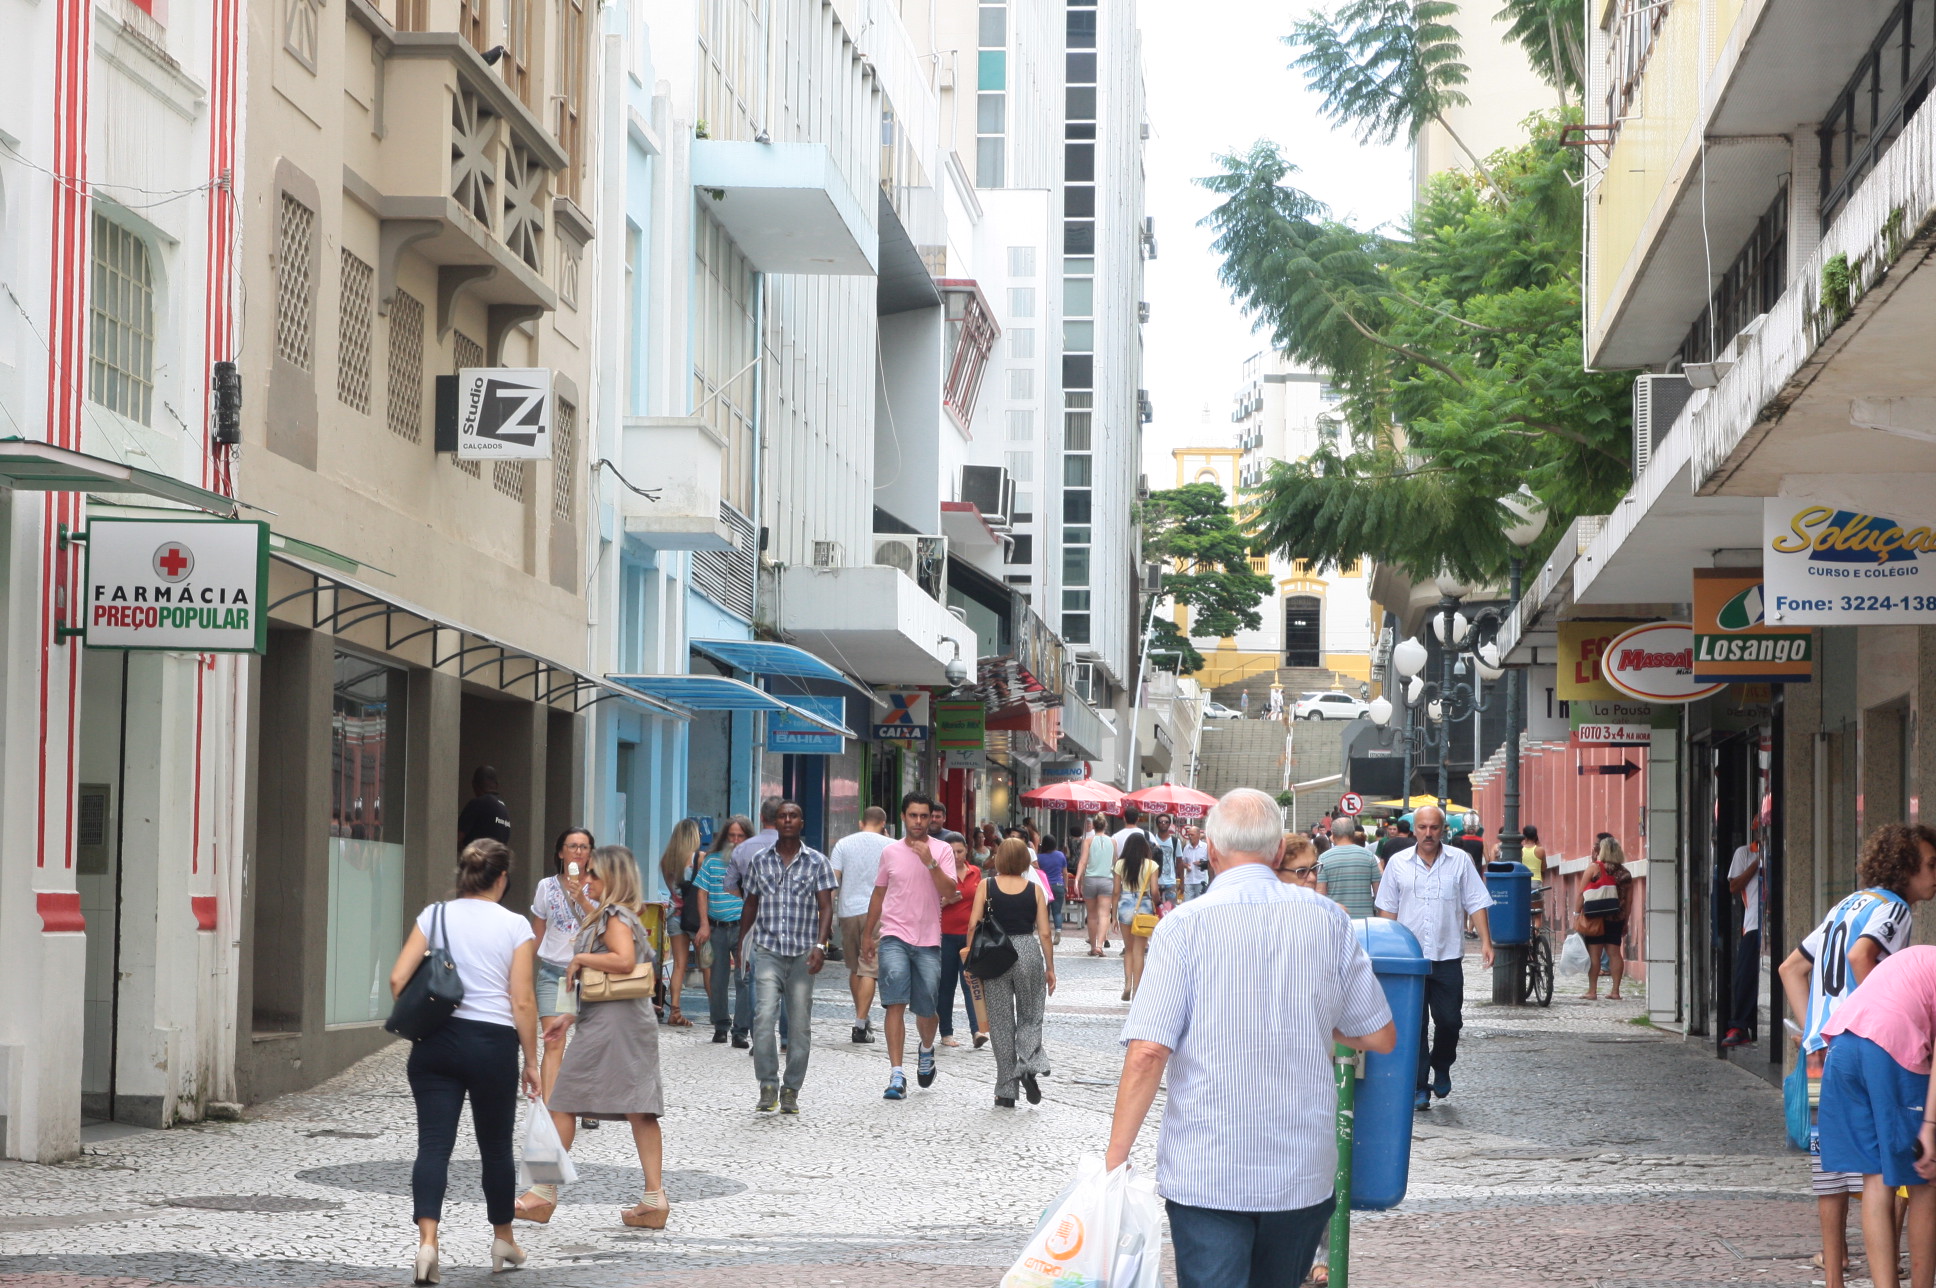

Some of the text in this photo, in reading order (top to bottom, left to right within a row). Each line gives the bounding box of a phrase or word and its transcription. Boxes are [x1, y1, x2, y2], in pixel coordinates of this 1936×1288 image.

[463, 377, 546, 435] Studio Z
[1808, 566, 1919, 578] CURSO E COLÉGIO
[94, 583, 249, 605] FARMÁCIA
[1776, 596, 1833, 611] Fone:
[1581, 634, 1620, 661] FO
[1699, 635, 1806, 663] Losango
[1594, 704, 1651, 716] La Pausa
[775, 734, 823, 743] BAHIA
[879, 727, 921, 738] CAIXA
[1580, 726, 1651, 740] FOTO 3x4 NA HORA
[1822, 920, 1847, 998] 10
